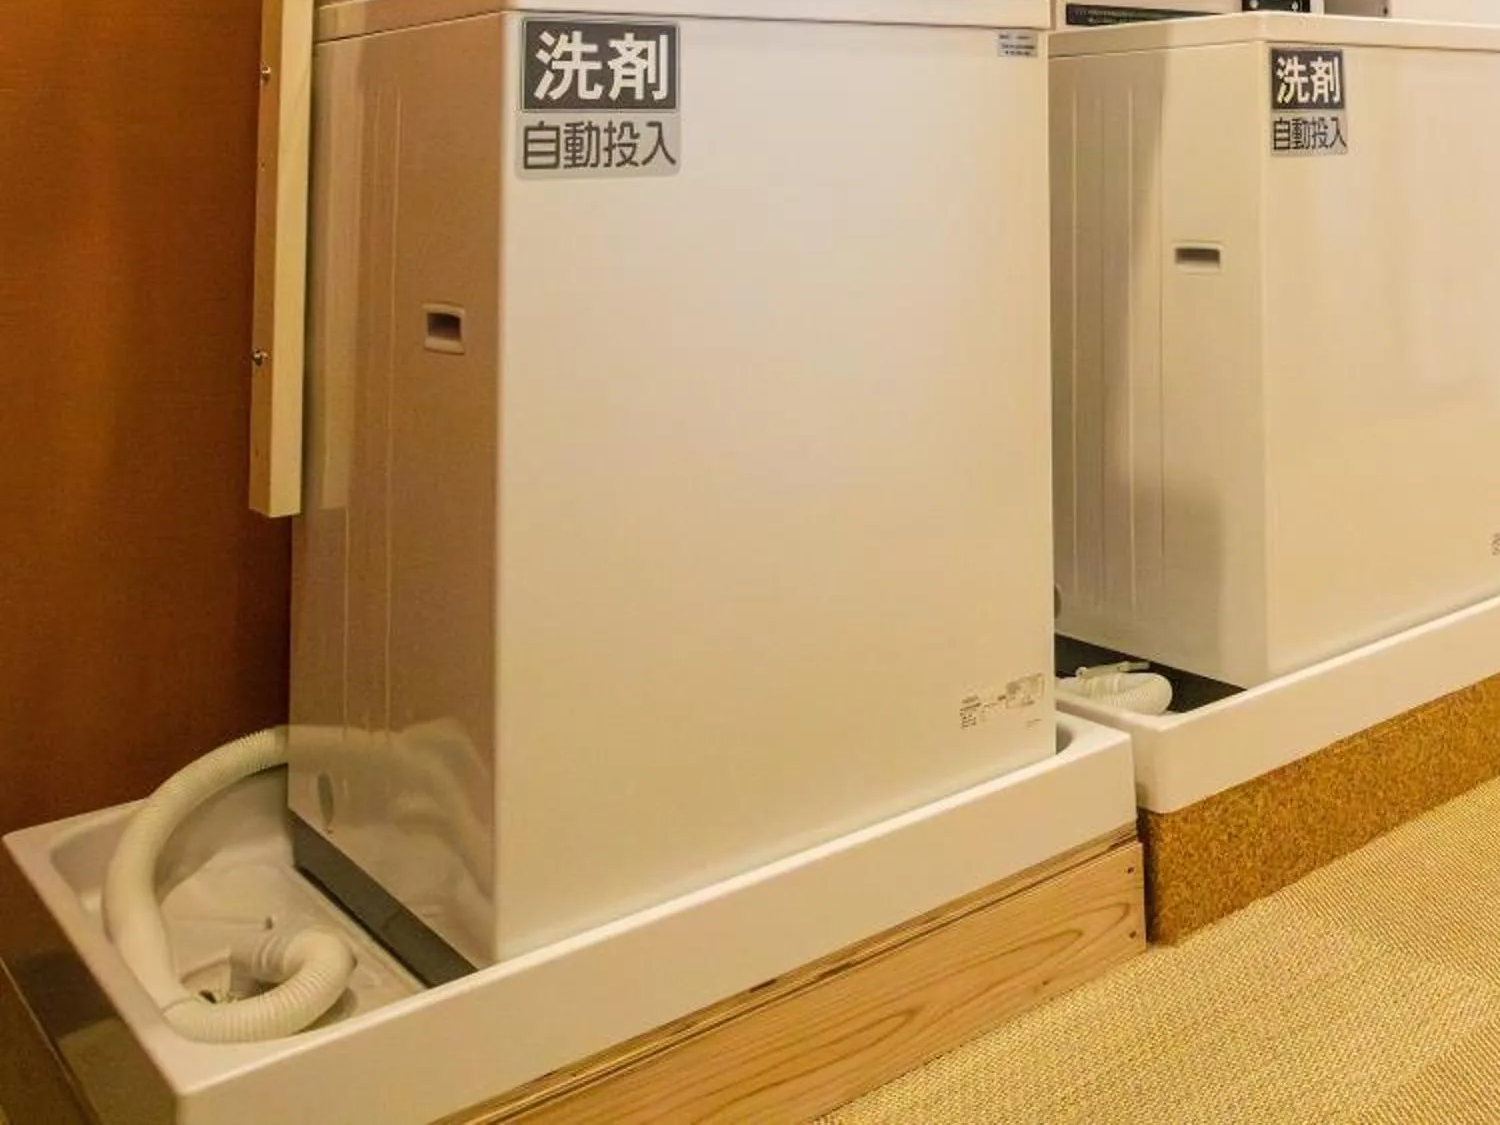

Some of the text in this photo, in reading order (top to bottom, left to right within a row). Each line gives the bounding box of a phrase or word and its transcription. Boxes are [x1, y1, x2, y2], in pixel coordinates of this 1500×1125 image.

[534, 31, 668, 102] 洗剤
[1276, 55, 1341, 103] 洗剤
[523, 120, 677, 171] 自動投入
[1273, 116, 1347, 150] 自動投入
